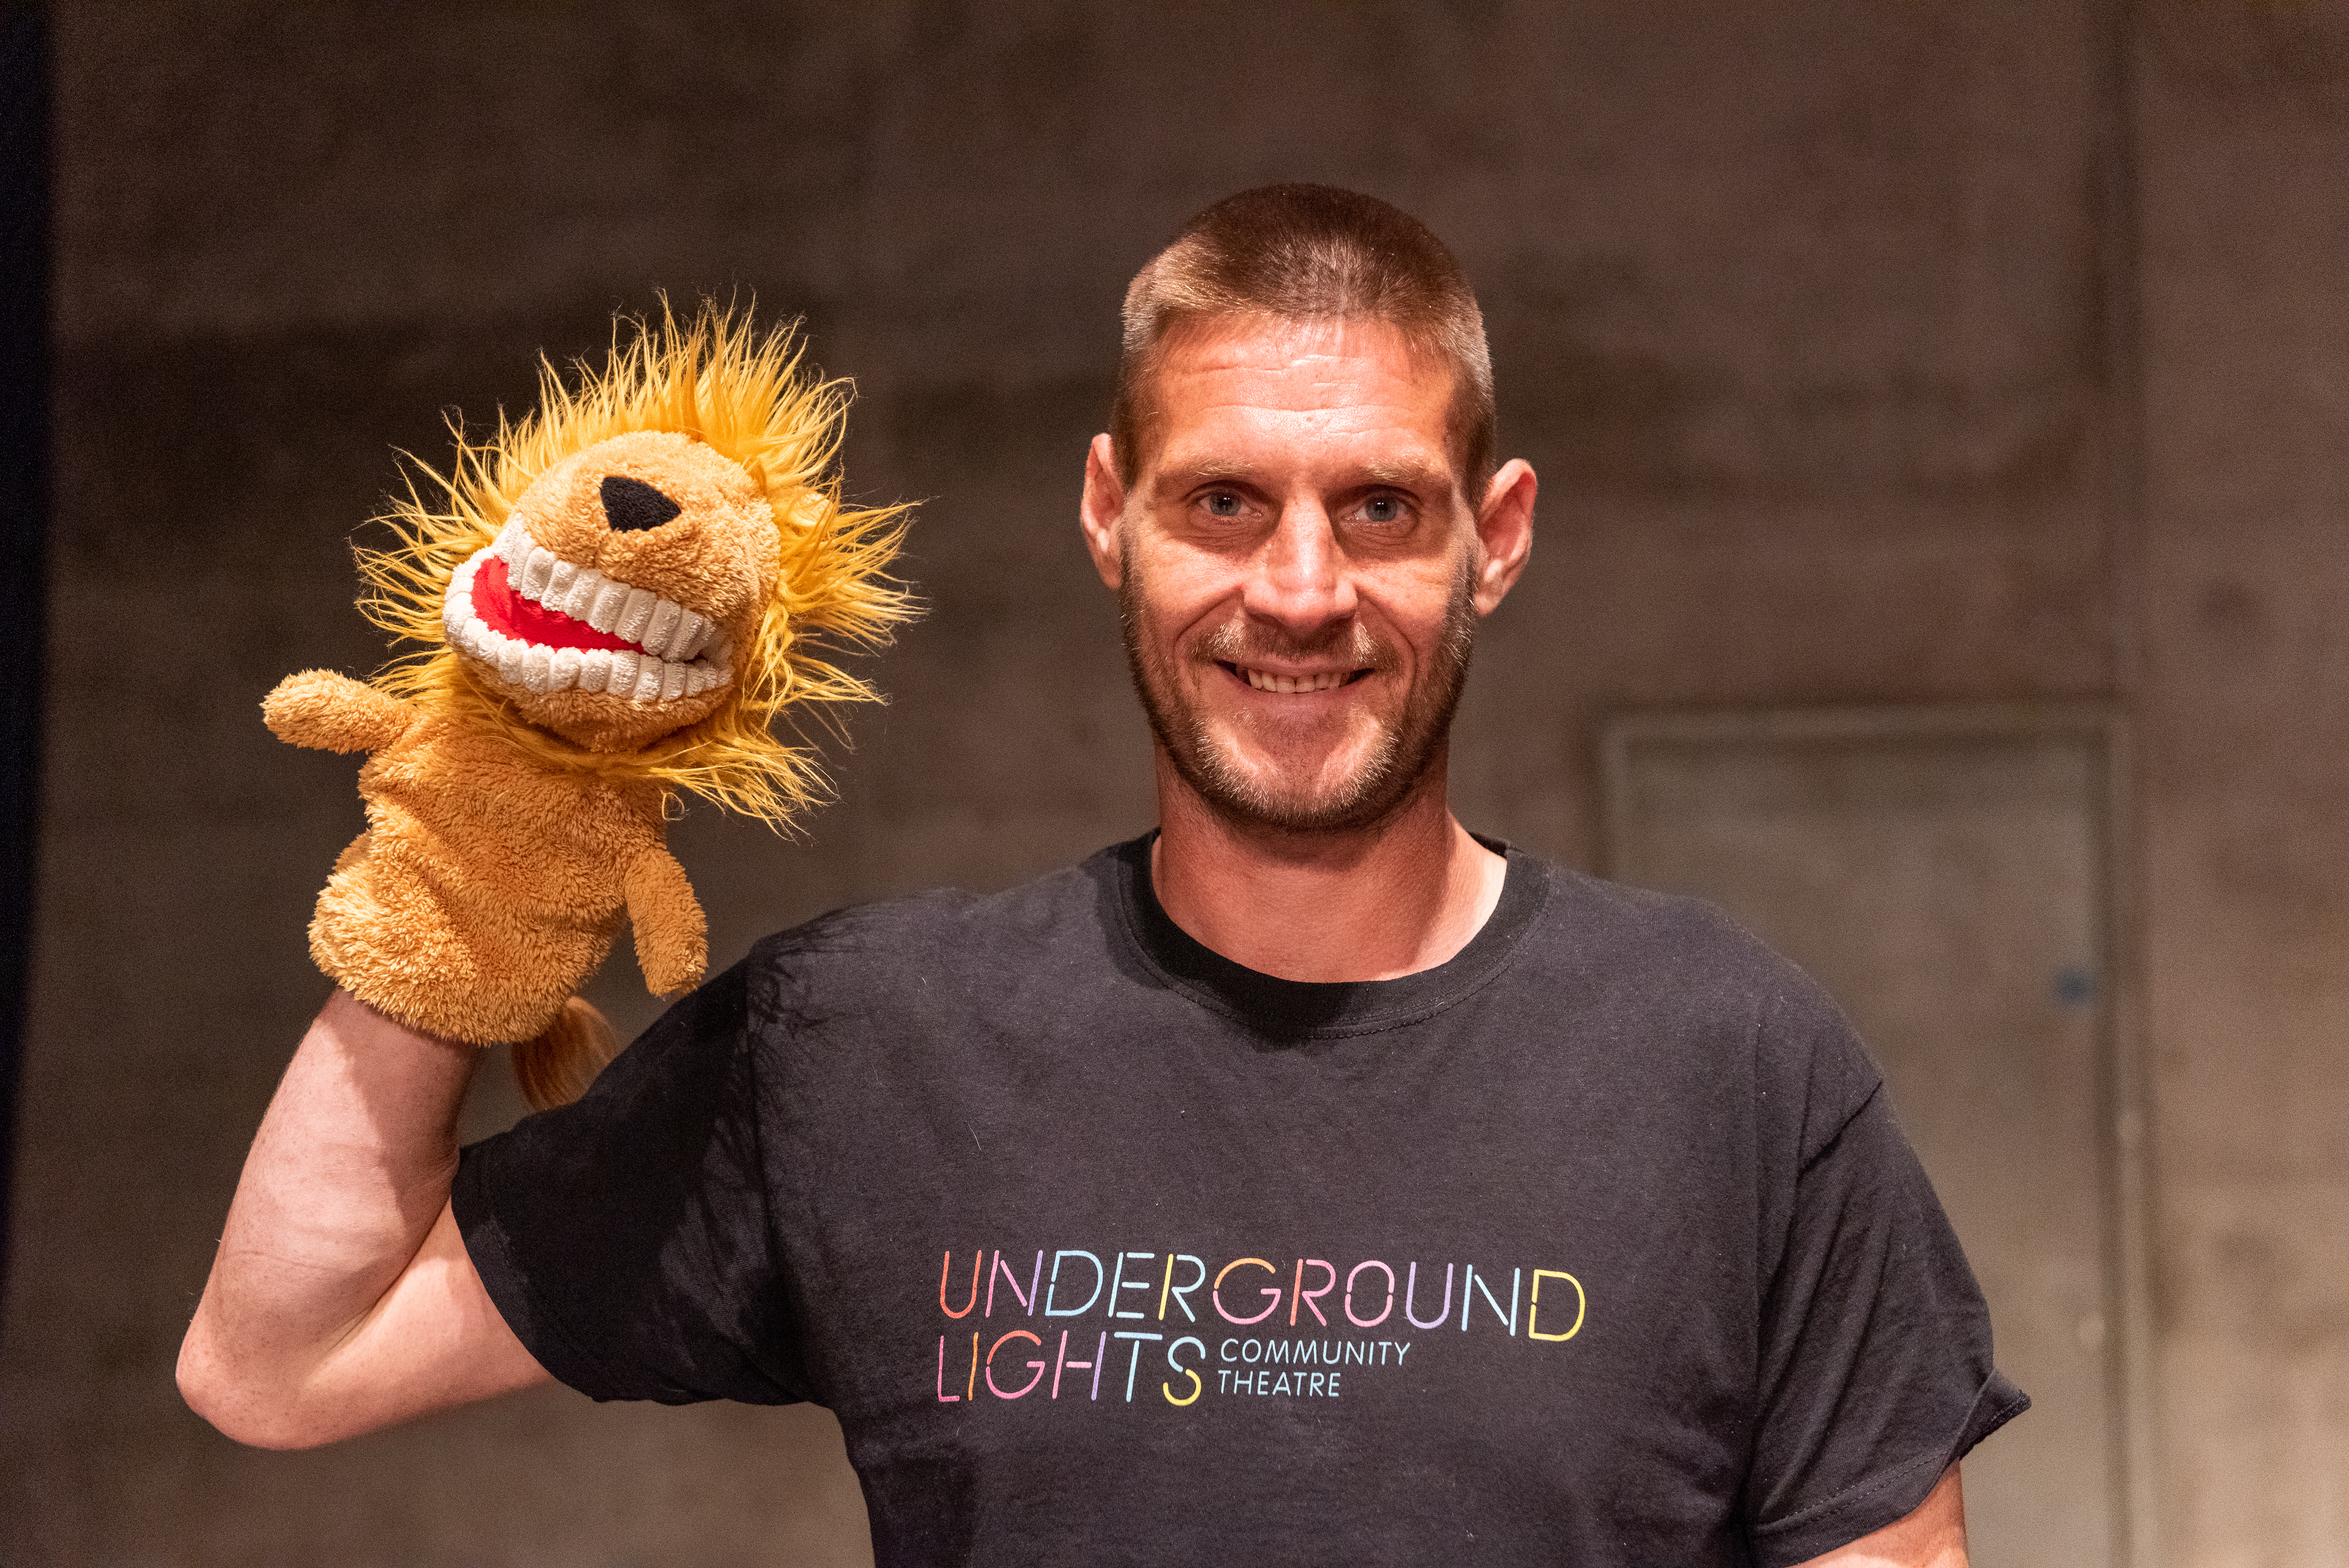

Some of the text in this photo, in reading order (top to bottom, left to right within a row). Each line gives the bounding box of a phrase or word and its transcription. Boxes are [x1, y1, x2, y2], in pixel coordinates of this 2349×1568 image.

[940, 1249, 1586, 1343] UNDERGROUND
[937, 1328, 1207, 1407] LIGHTS
[1220, 1338, 1411, 1367] COMMUNITY
[1218, 1370, 1341, 1398] THEATRE
